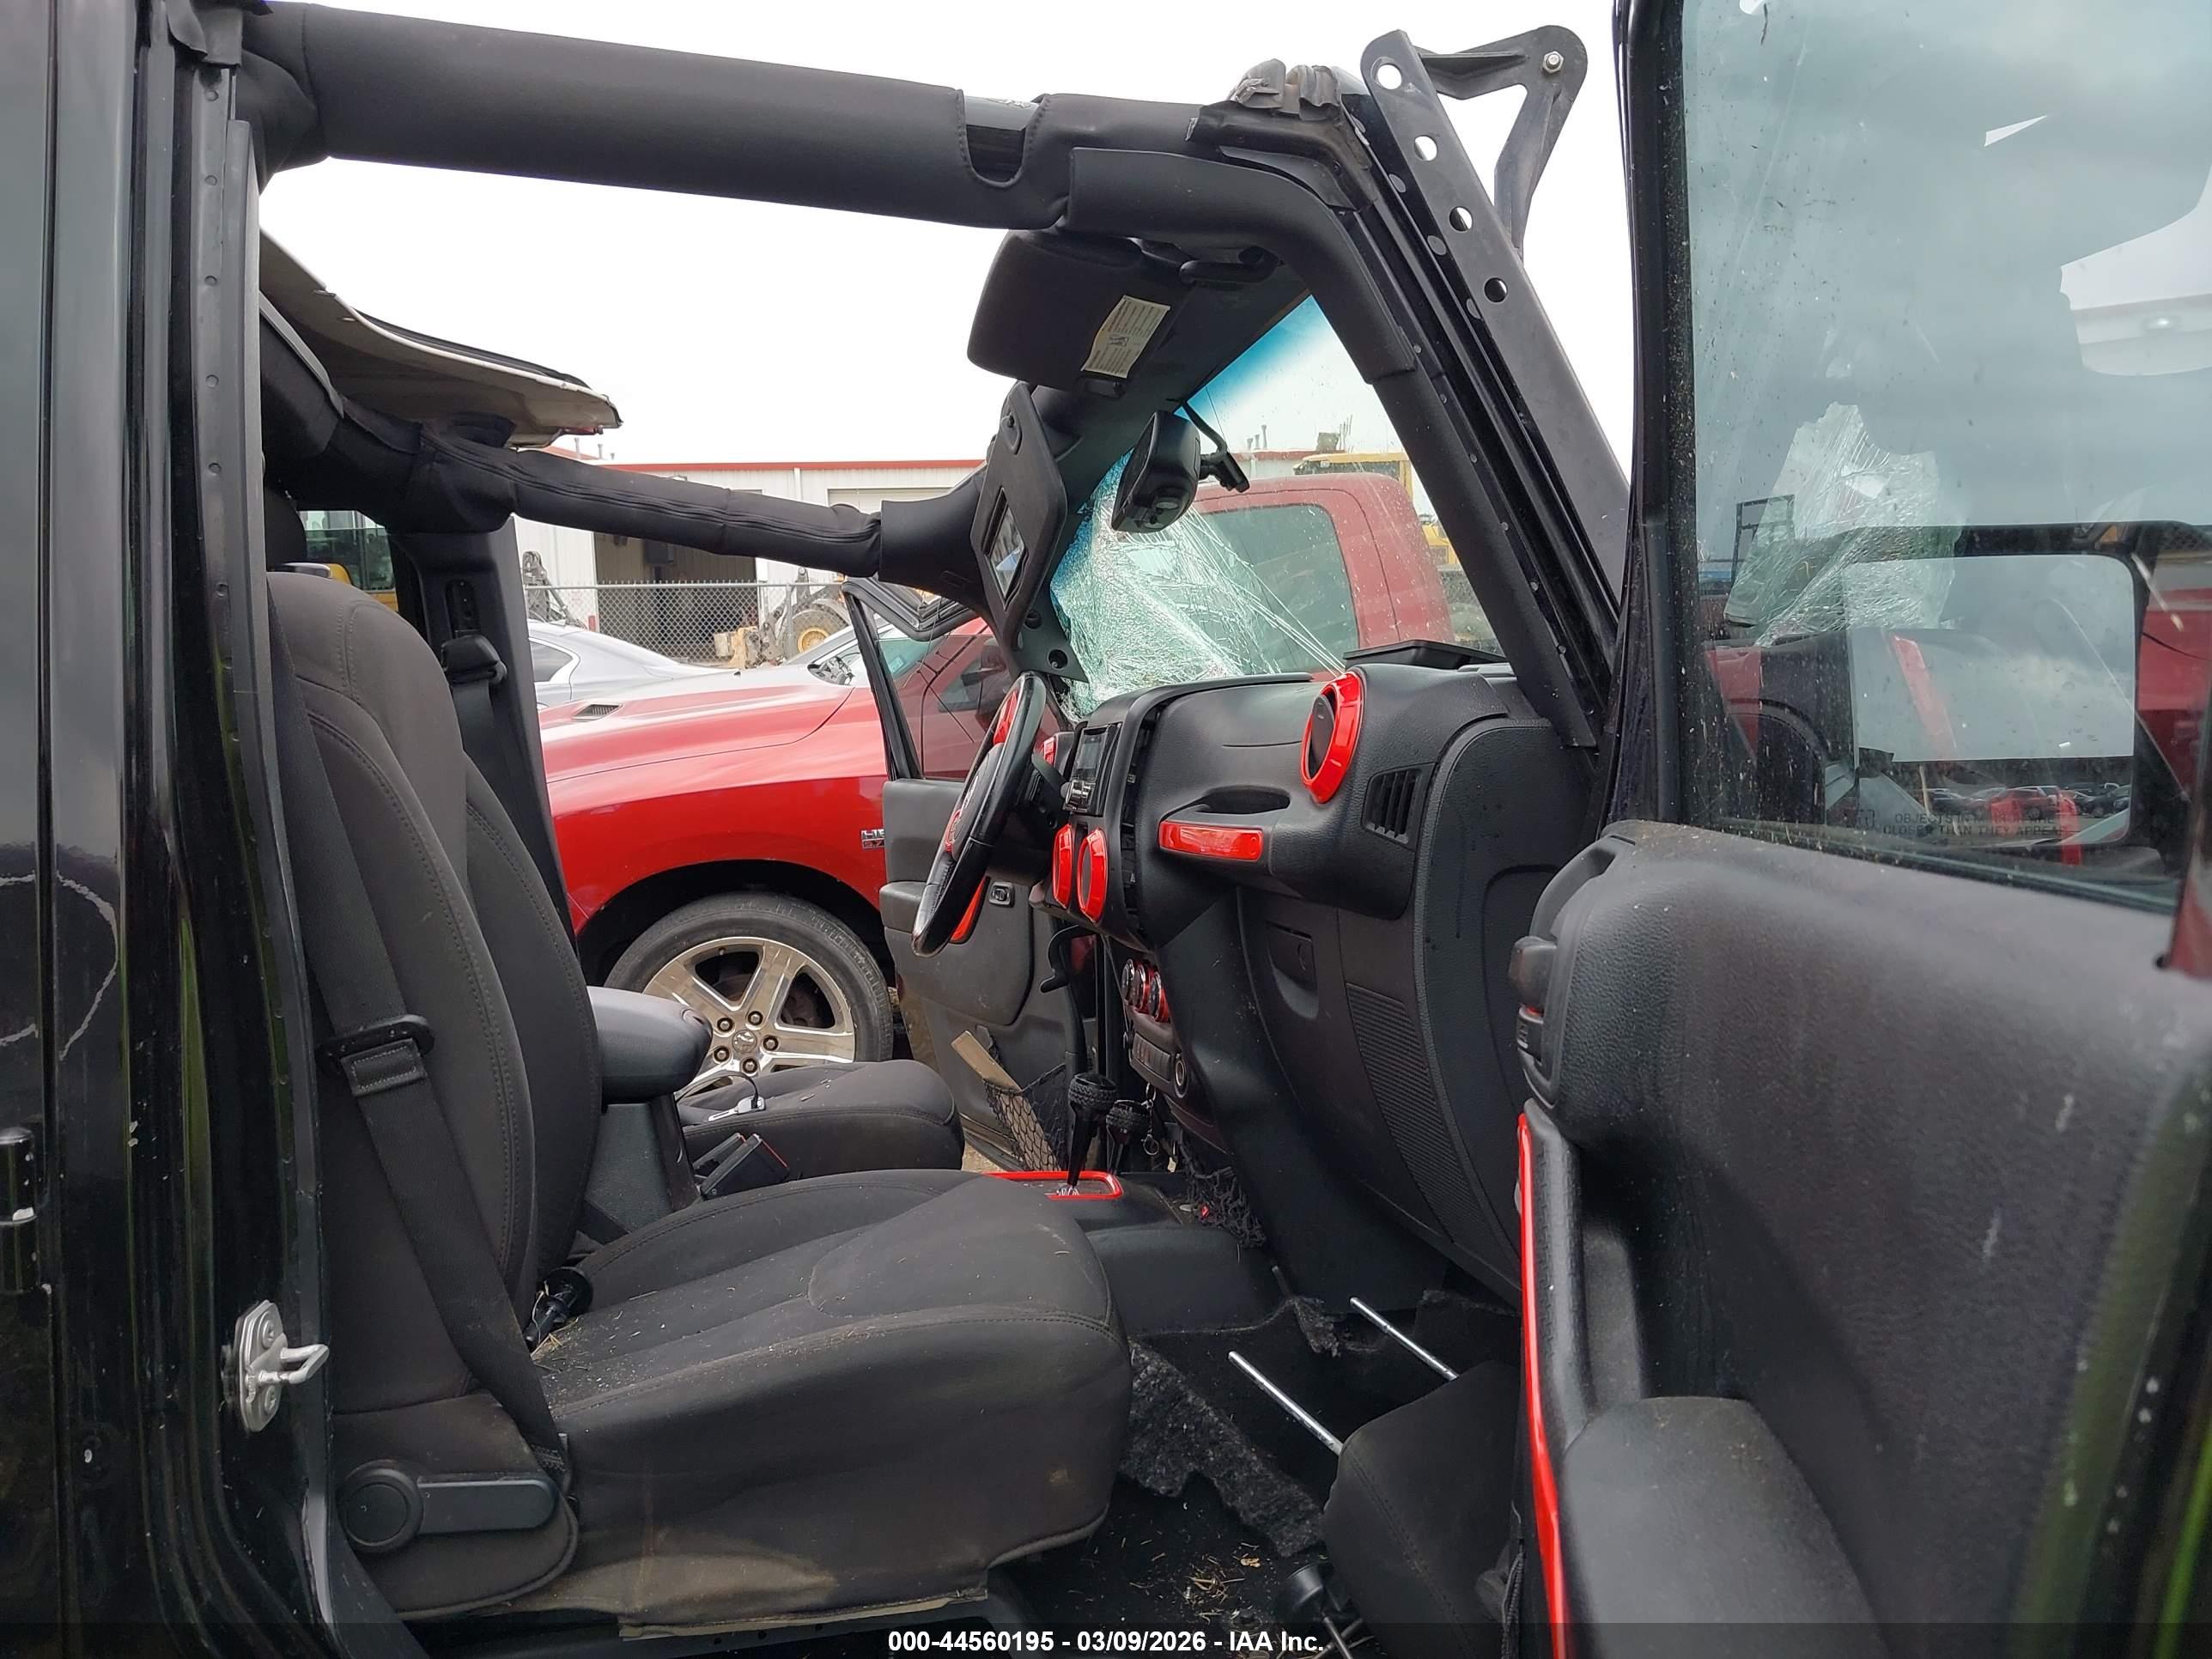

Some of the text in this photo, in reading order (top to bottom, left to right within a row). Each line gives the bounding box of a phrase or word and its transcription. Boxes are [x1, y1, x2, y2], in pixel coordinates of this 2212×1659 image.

[1894, 812, 1952, 824] OBJECTS
[860, 829, 885, 839] HE
[1883, 824, 2068, 836] CLOSER THAN THEY APPEAR
